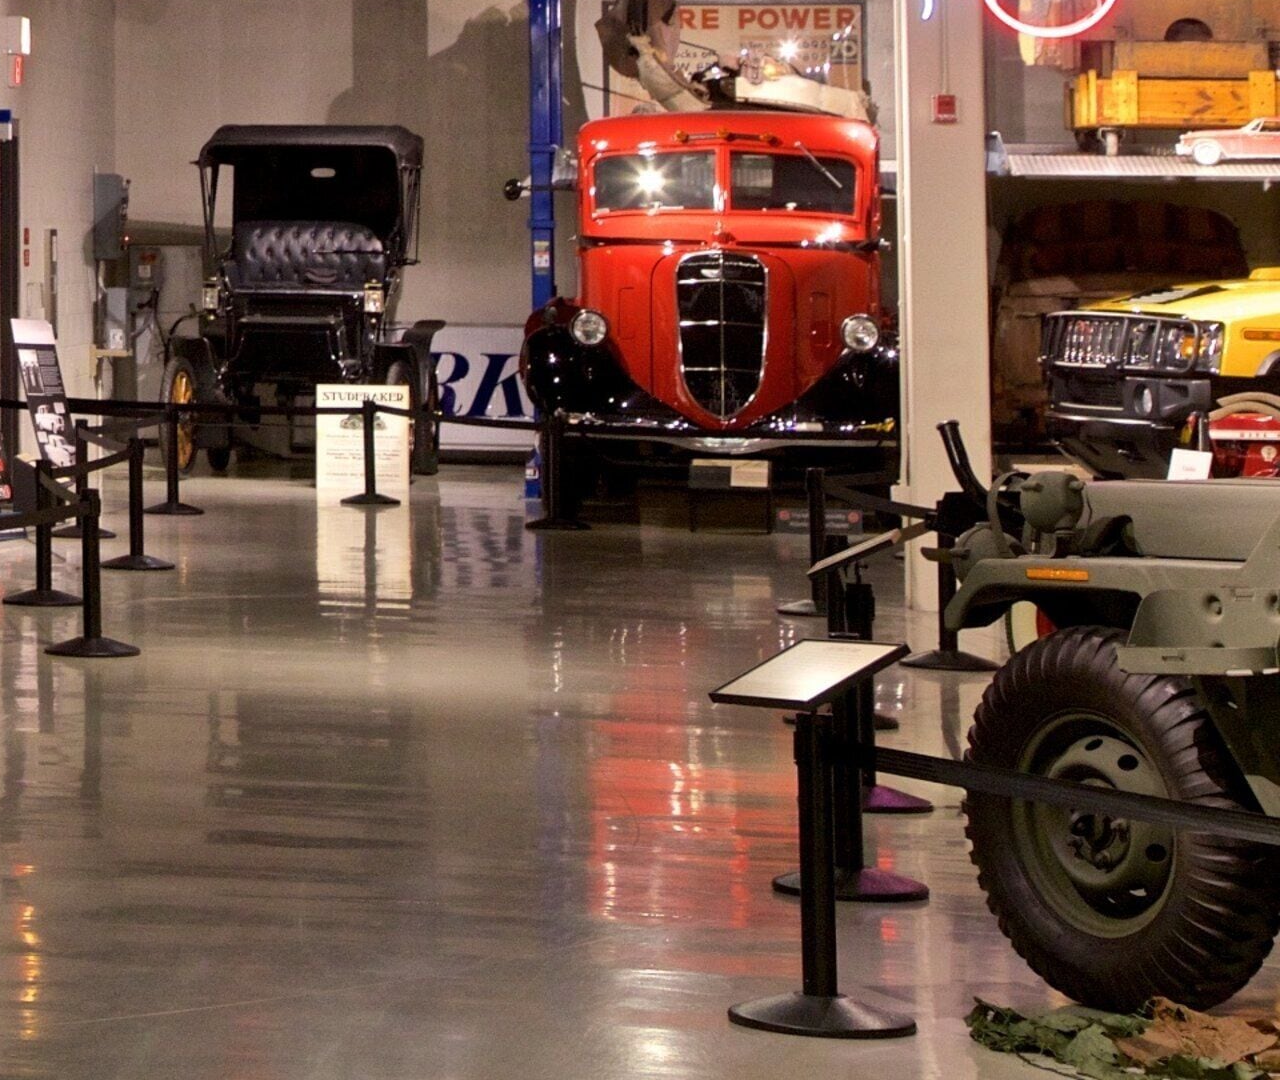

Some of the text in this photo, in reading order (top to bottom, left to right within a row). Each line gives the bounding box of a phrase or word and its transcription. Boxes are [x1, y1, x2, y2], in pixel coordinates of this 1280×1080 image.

[679, 8, 856, 30] RE POWER
[322, 391, 404, 402] STUDEBAKER
